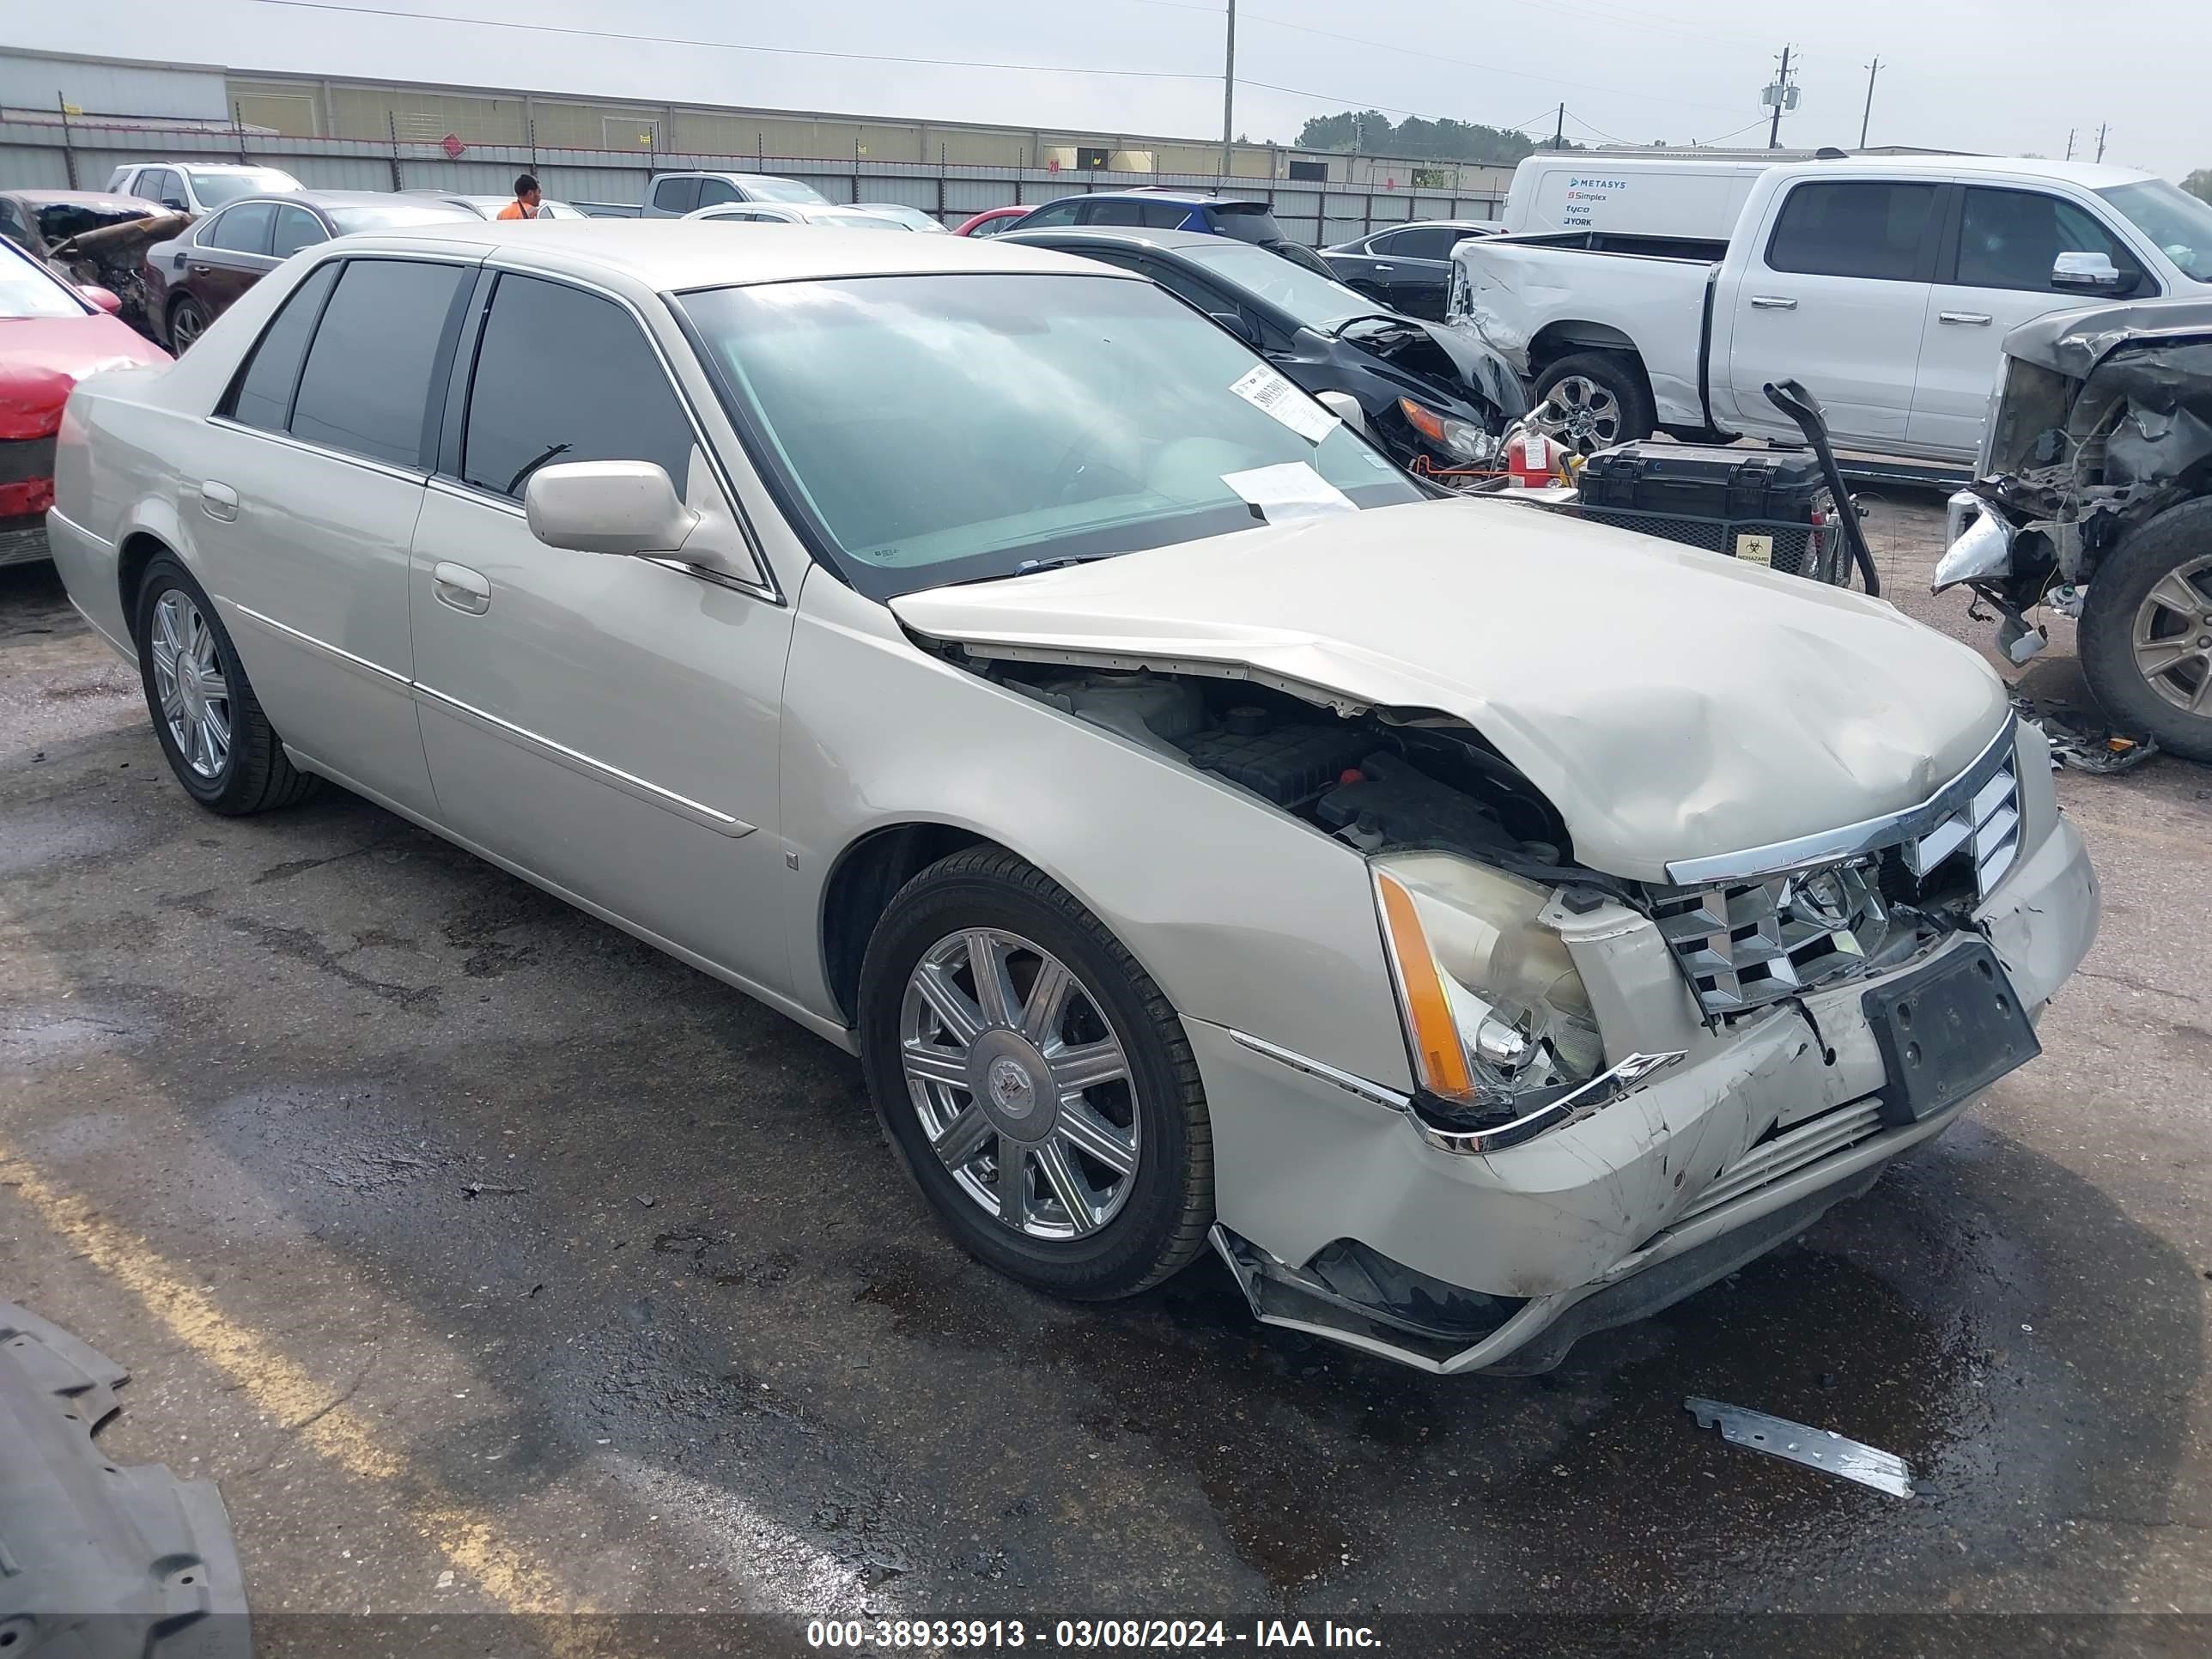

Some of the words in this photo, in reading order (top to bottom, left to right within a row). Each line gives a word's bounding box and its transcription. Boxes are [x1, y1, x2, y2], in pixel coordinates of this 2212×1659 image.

[1580, 179, 1626, 189] METASYS
[1575, 191, 1607, 201] Simplex
[1565, 204, 1590, 214] tyco
[1571, 217, 1592, 226] YORK
